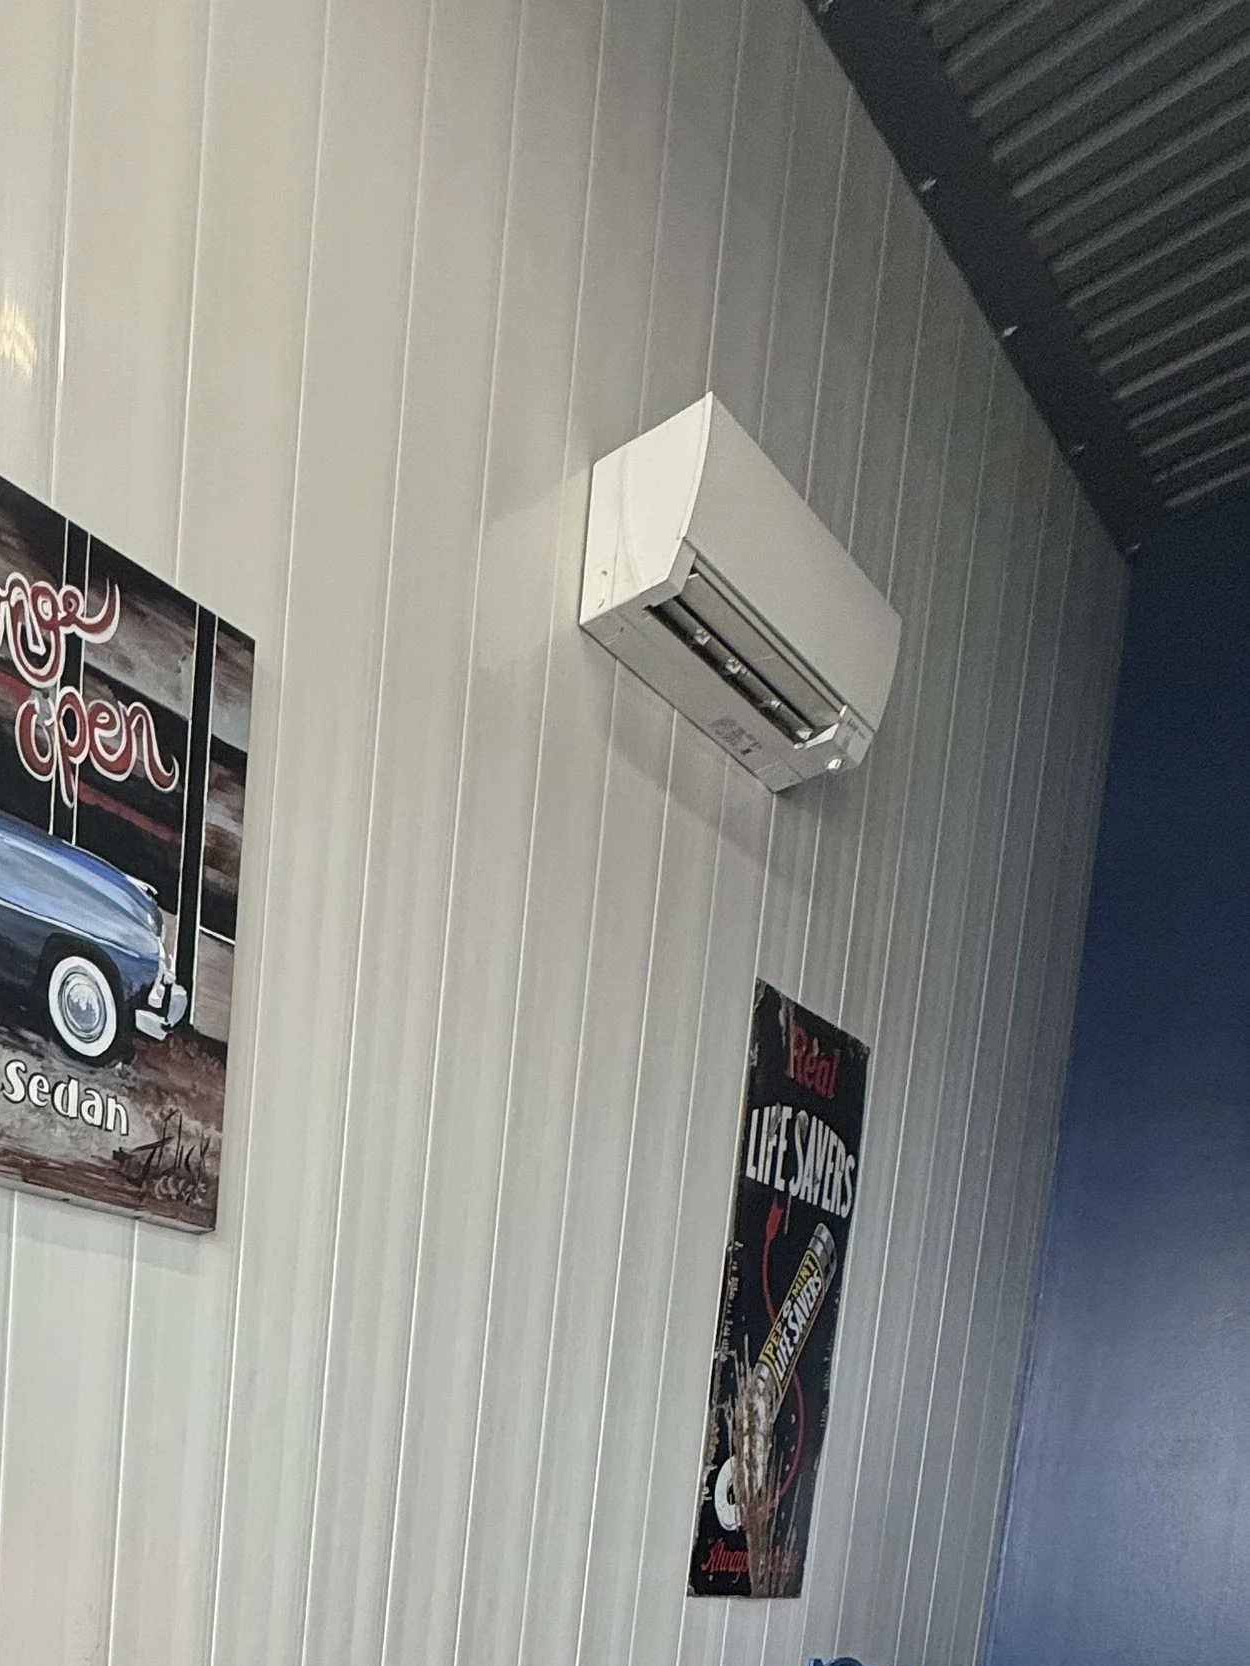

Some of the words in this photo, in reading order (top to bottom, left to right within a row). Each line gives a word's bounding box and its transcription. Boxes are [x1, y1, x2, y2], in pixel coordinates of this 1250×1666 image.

[1, 1057, 130, 1137] Sedan
[788, 1027, 841, 1100] Real
[745, 1104, 793, 1192] LIFE
[789, 1110, 856, 1219] SAVERS
[774, 1326, 795, 1382] LIFE
[787, 1269, 822, 1344] SAVERS
